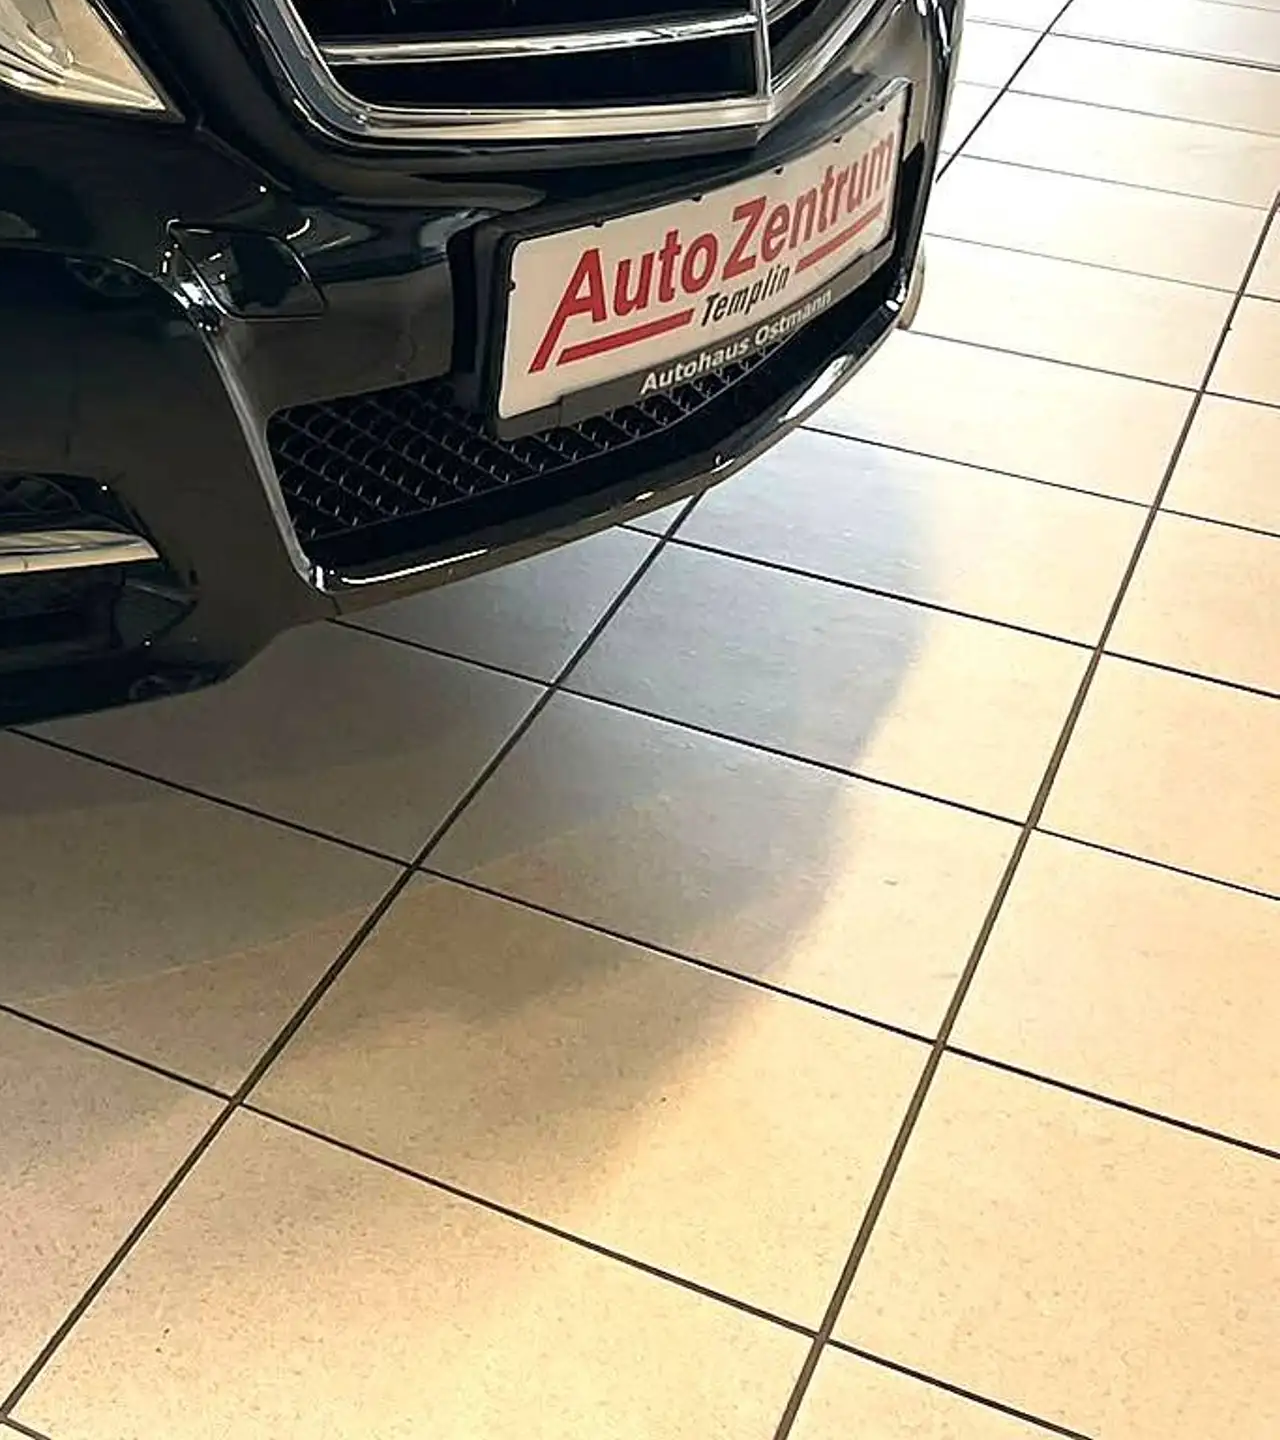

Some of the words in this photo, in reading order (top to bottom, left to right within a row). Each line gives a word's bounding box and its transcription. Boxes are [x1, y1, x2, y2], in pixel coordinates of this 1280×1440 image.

[527, 132, 895, 374] AutoZentrum
[700, 263, 790, 327] Templin
[640, 334, 749, 395] Autohaus
[754, 288, 833, 347] Ostmann
